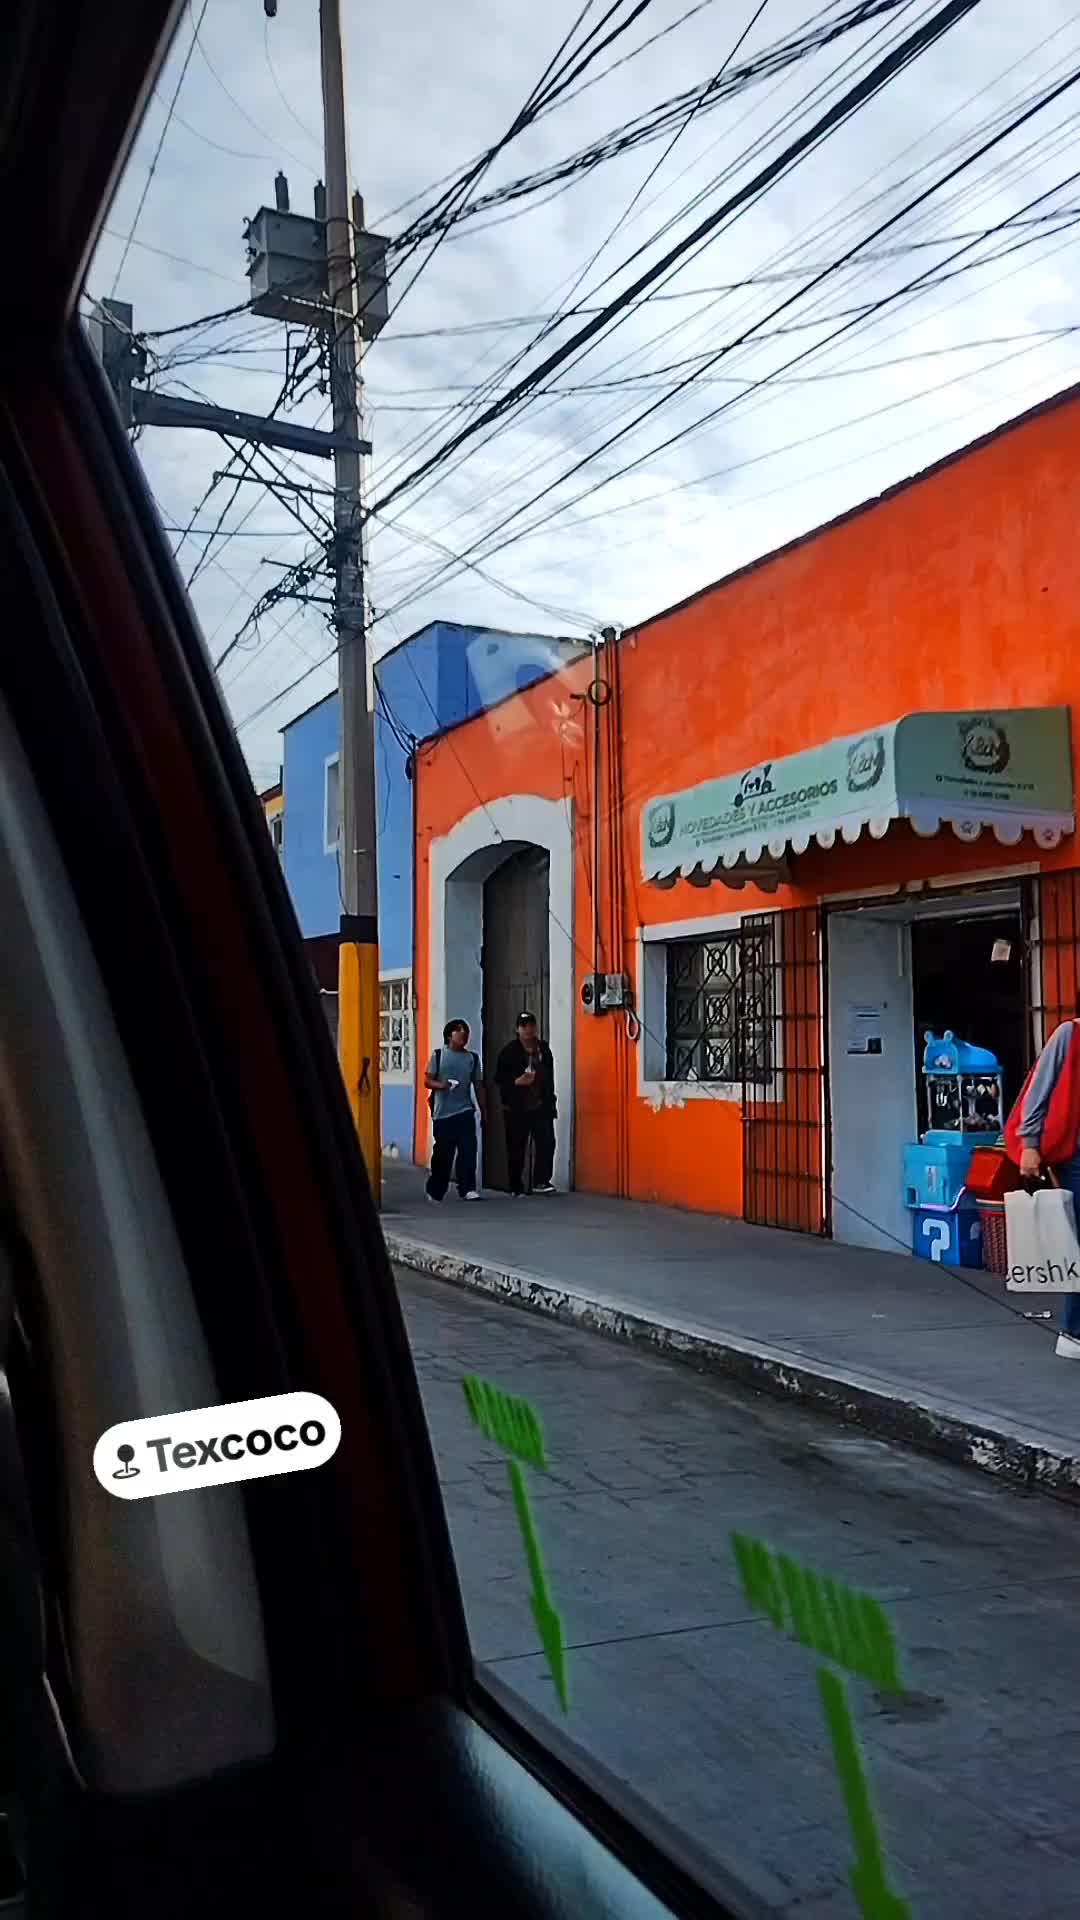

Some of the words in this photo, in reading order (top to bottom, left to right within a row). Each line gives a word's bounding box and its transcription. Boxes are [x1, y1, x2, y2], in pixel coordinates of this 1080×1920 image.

[678, 806, 746, 837] NOVEDADES
[758, 779, 838, 814] ACCESORIOS
[1006, 1258, 1080, 1283] ershk
